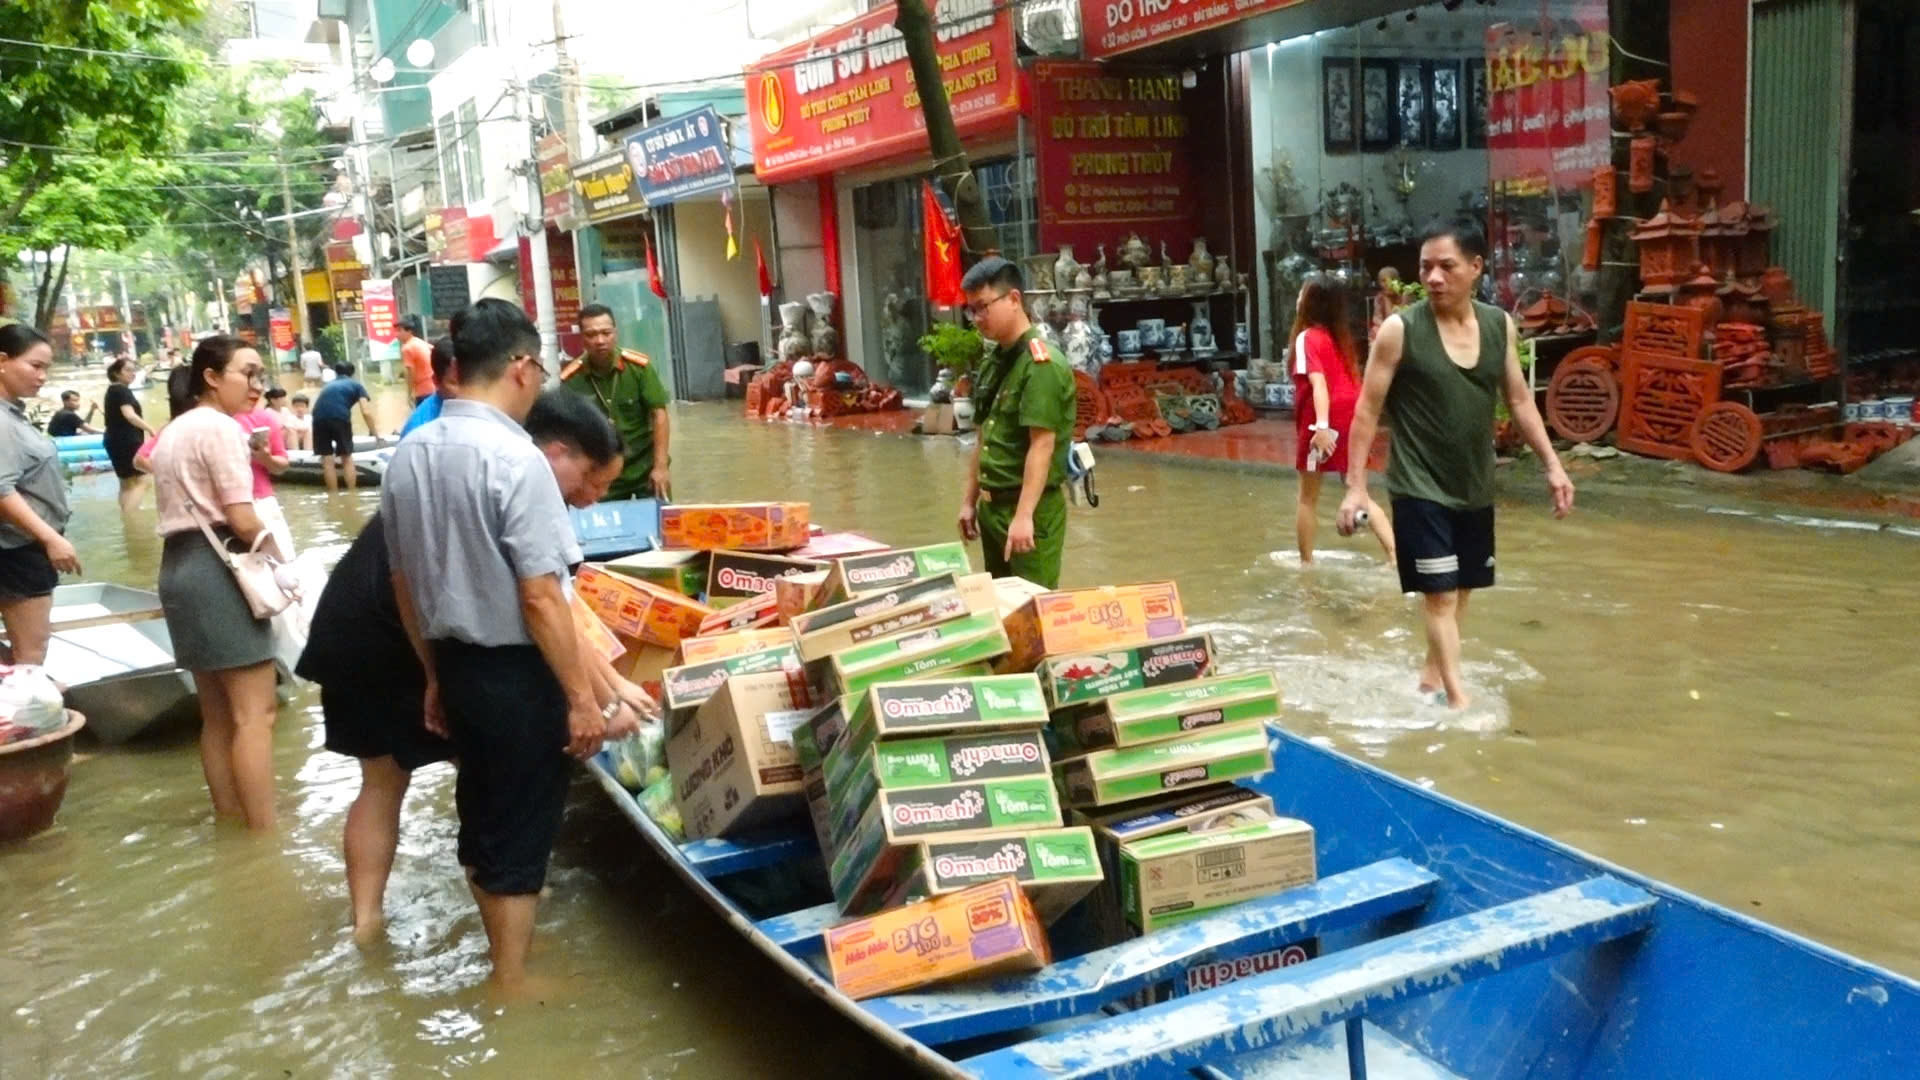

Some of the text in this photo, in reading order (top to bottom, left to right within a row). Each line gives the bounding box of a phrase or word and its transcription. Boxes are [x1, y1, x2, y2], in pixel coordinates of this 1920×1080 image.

[717, 567, 775, 593] Omac
[848, 557, 909, 584] Omachi
[1088, 600, 1124, 625] BIG
[914, 656, 937, 672] Tôm
[884, 694, 964, 718] Omachi
[960, 742, 1040, 767] Omachi
[893, 798, 976, 826] Omachi
[936, 851, 1018, 879] Omachi
[891, 916, 941, 954] BIG
[1187, 945, 1307, 993] Omachi
